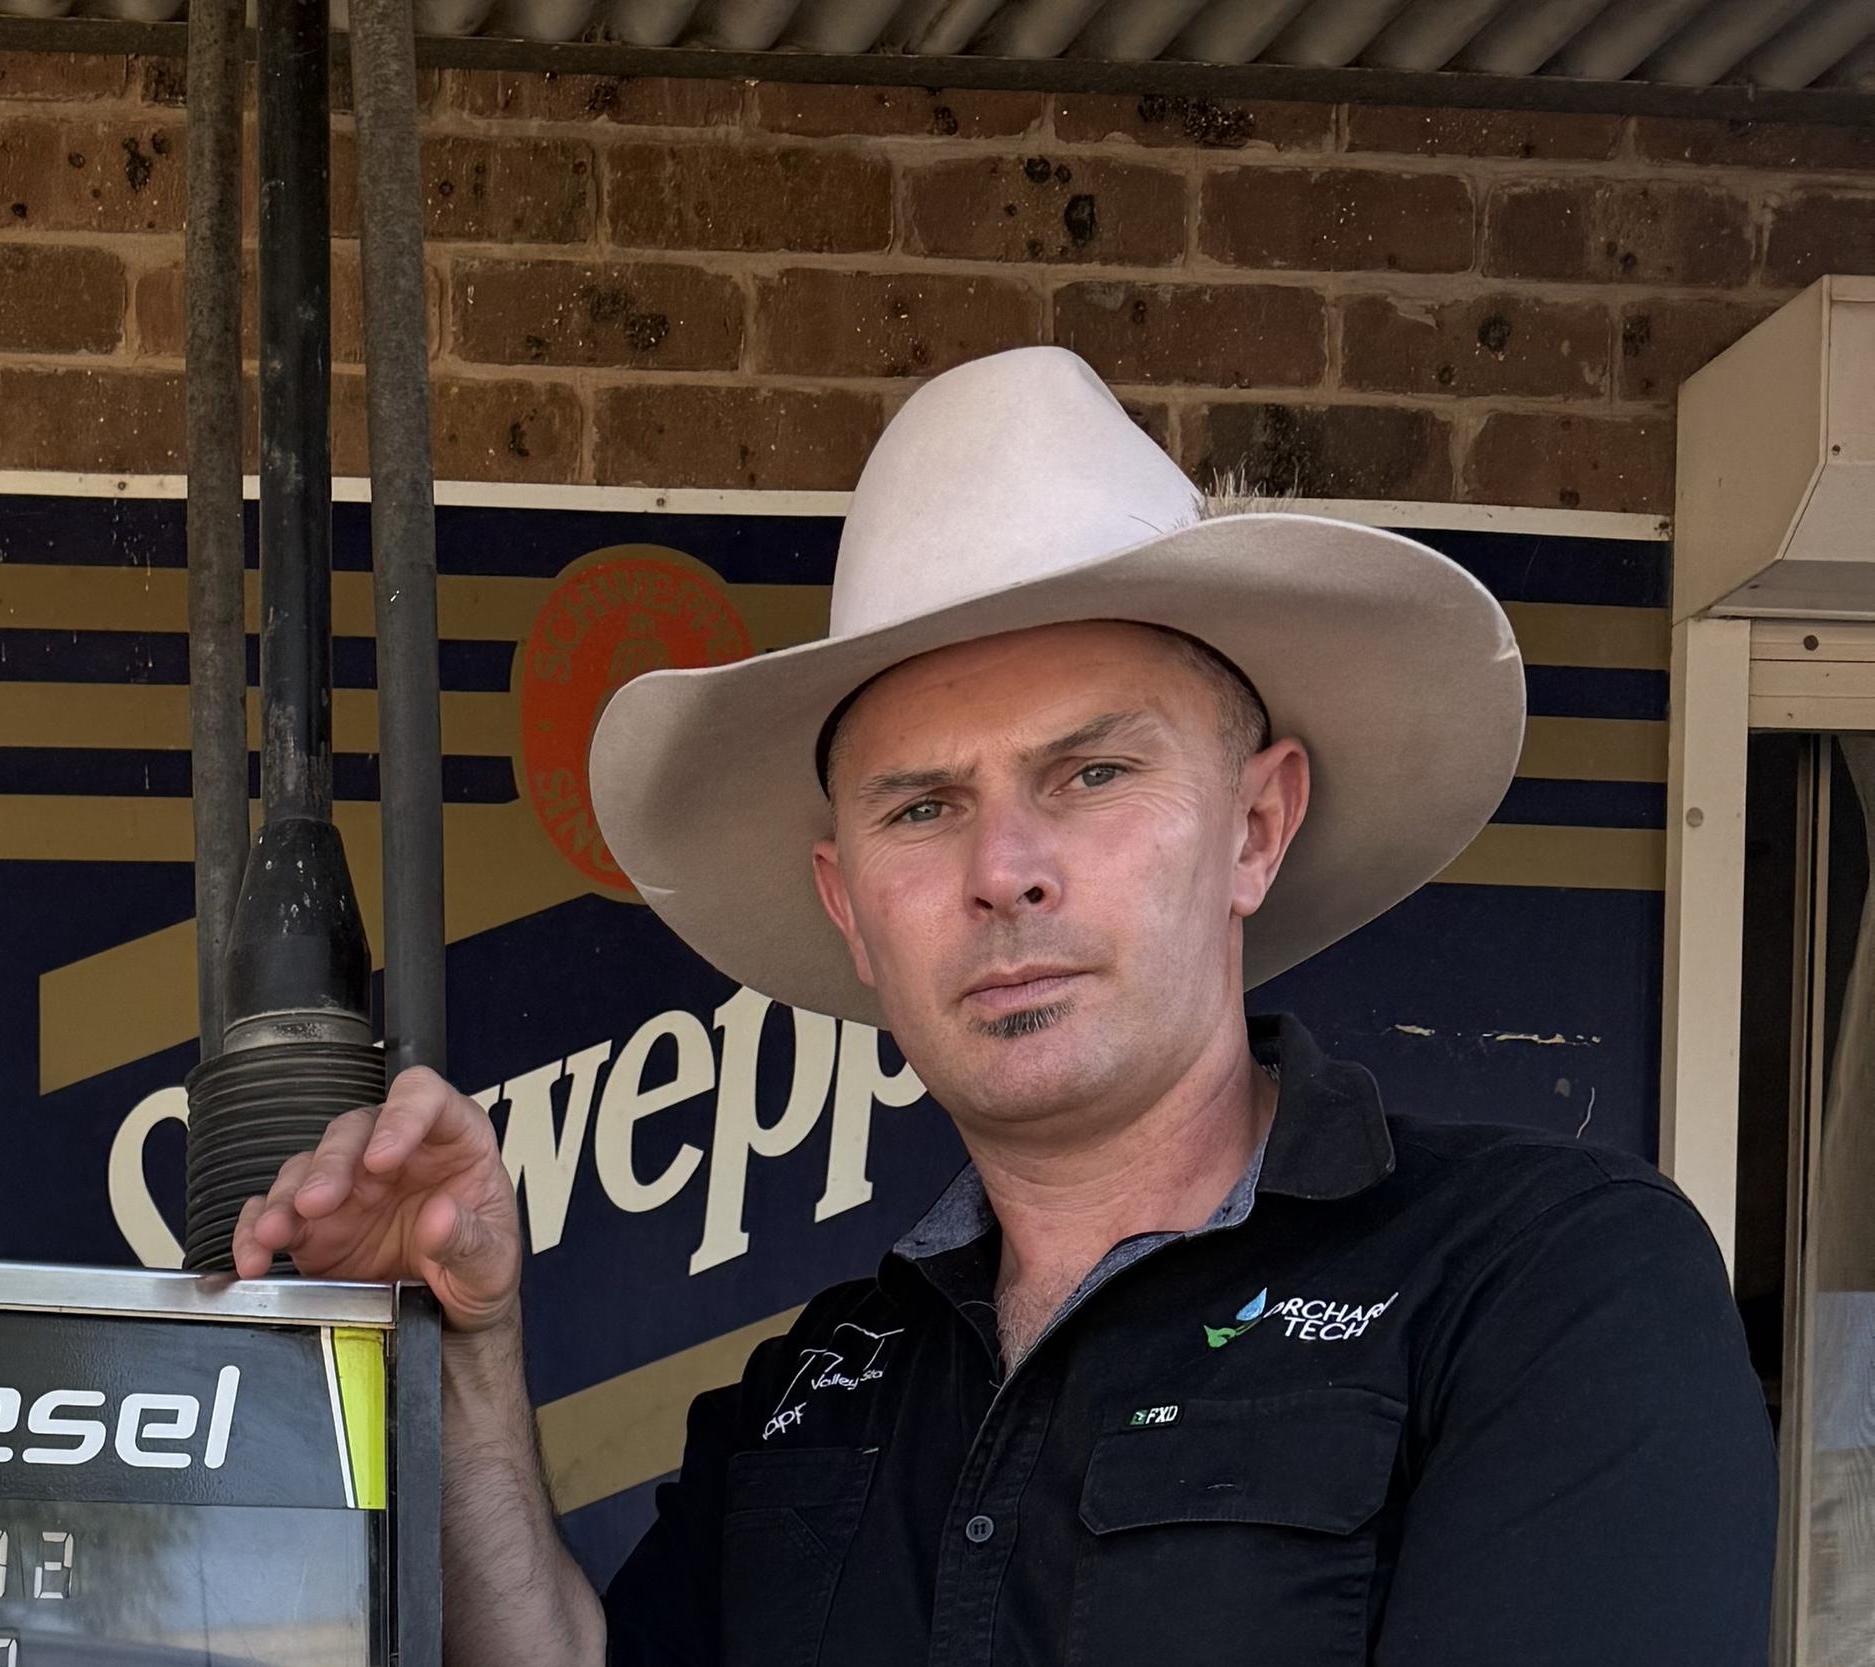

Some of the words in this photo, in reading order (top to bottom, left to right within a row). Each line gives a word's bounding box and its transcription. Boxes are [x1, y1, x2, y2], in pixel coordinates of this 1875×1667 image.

[532, 571, 742, 683] SCHWEPPE
[1283, 1316, 1369, 1341] TECH
[811, 1373, 859, 1390] Valley
[1145, 1405, 1178, 1424] FXD
